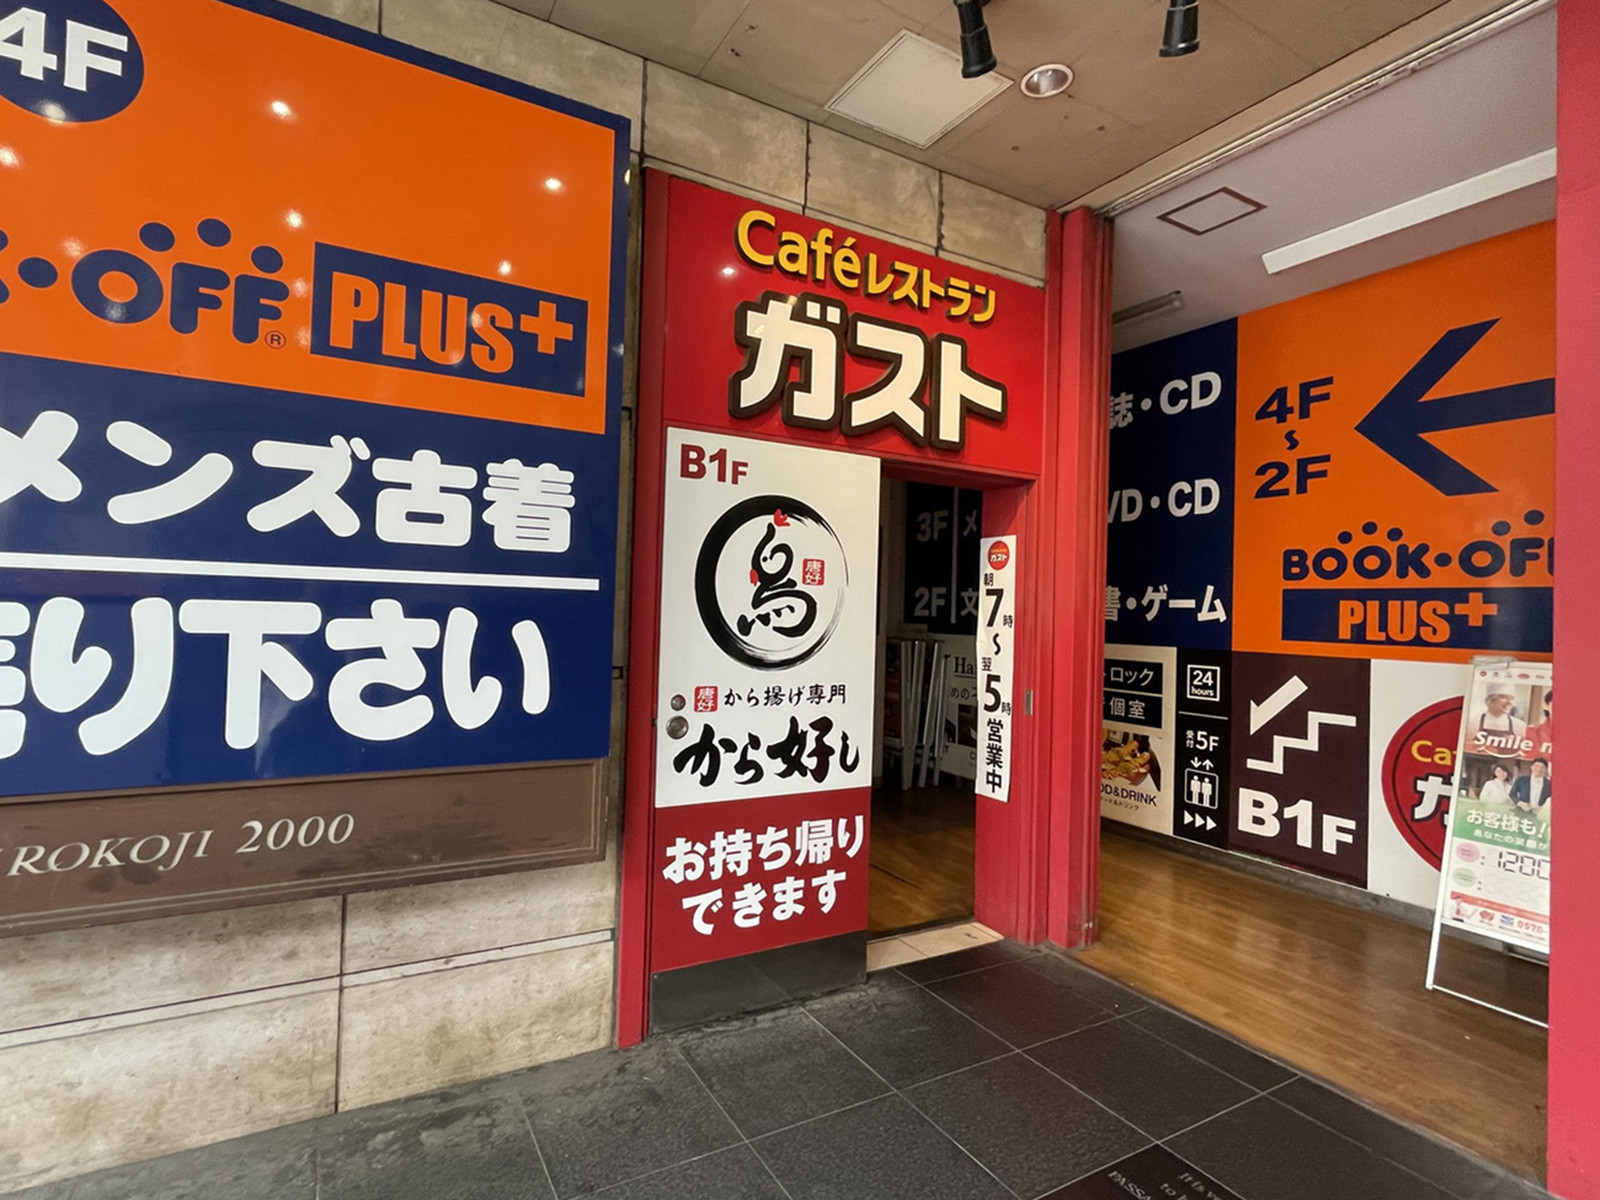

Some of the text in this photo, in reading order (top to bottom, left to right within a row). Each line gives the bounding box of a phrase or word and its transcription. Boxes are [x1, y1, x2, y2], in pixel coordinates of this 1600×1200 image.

[0, 7, 128, 92] 4F
[330, 271, 573, 374] PLUS+
[735, 296, 1005, 446] ガスト
[1255, 376, 1334, 424] 4F
[0, 410, 576, 554] メンズ古着
[680, 443, 749, 485] B1F
[1254, 454, 1331, 499] 2F
[916, 510, 949, 543] 3F
[913, 586, 947, 617] 2F
[1338, 592, 1498, 643] PLUS+
[724, 684, 846, 706] から揚げ専門
[1103, 667, 1154, 687] ロック
[1191, 685, 1215, 697] hours
[1192, 670, 1214, 687] 24
[1103, 697, 1146, 720] 個室
[673, 716, 860, 787] から好し
[1196, 730, 1219, 751] 5F
[1411, 740, 1457, 766] Ca
[1474, 731, 1533, 750] Smile
[1238, 788, 1356, 855] B1F
[0, 813, 354, 876] ROKOJI 2000
[662, 815, 864, 884] お持ち帰り
[682, 869, 847, 936] できます
